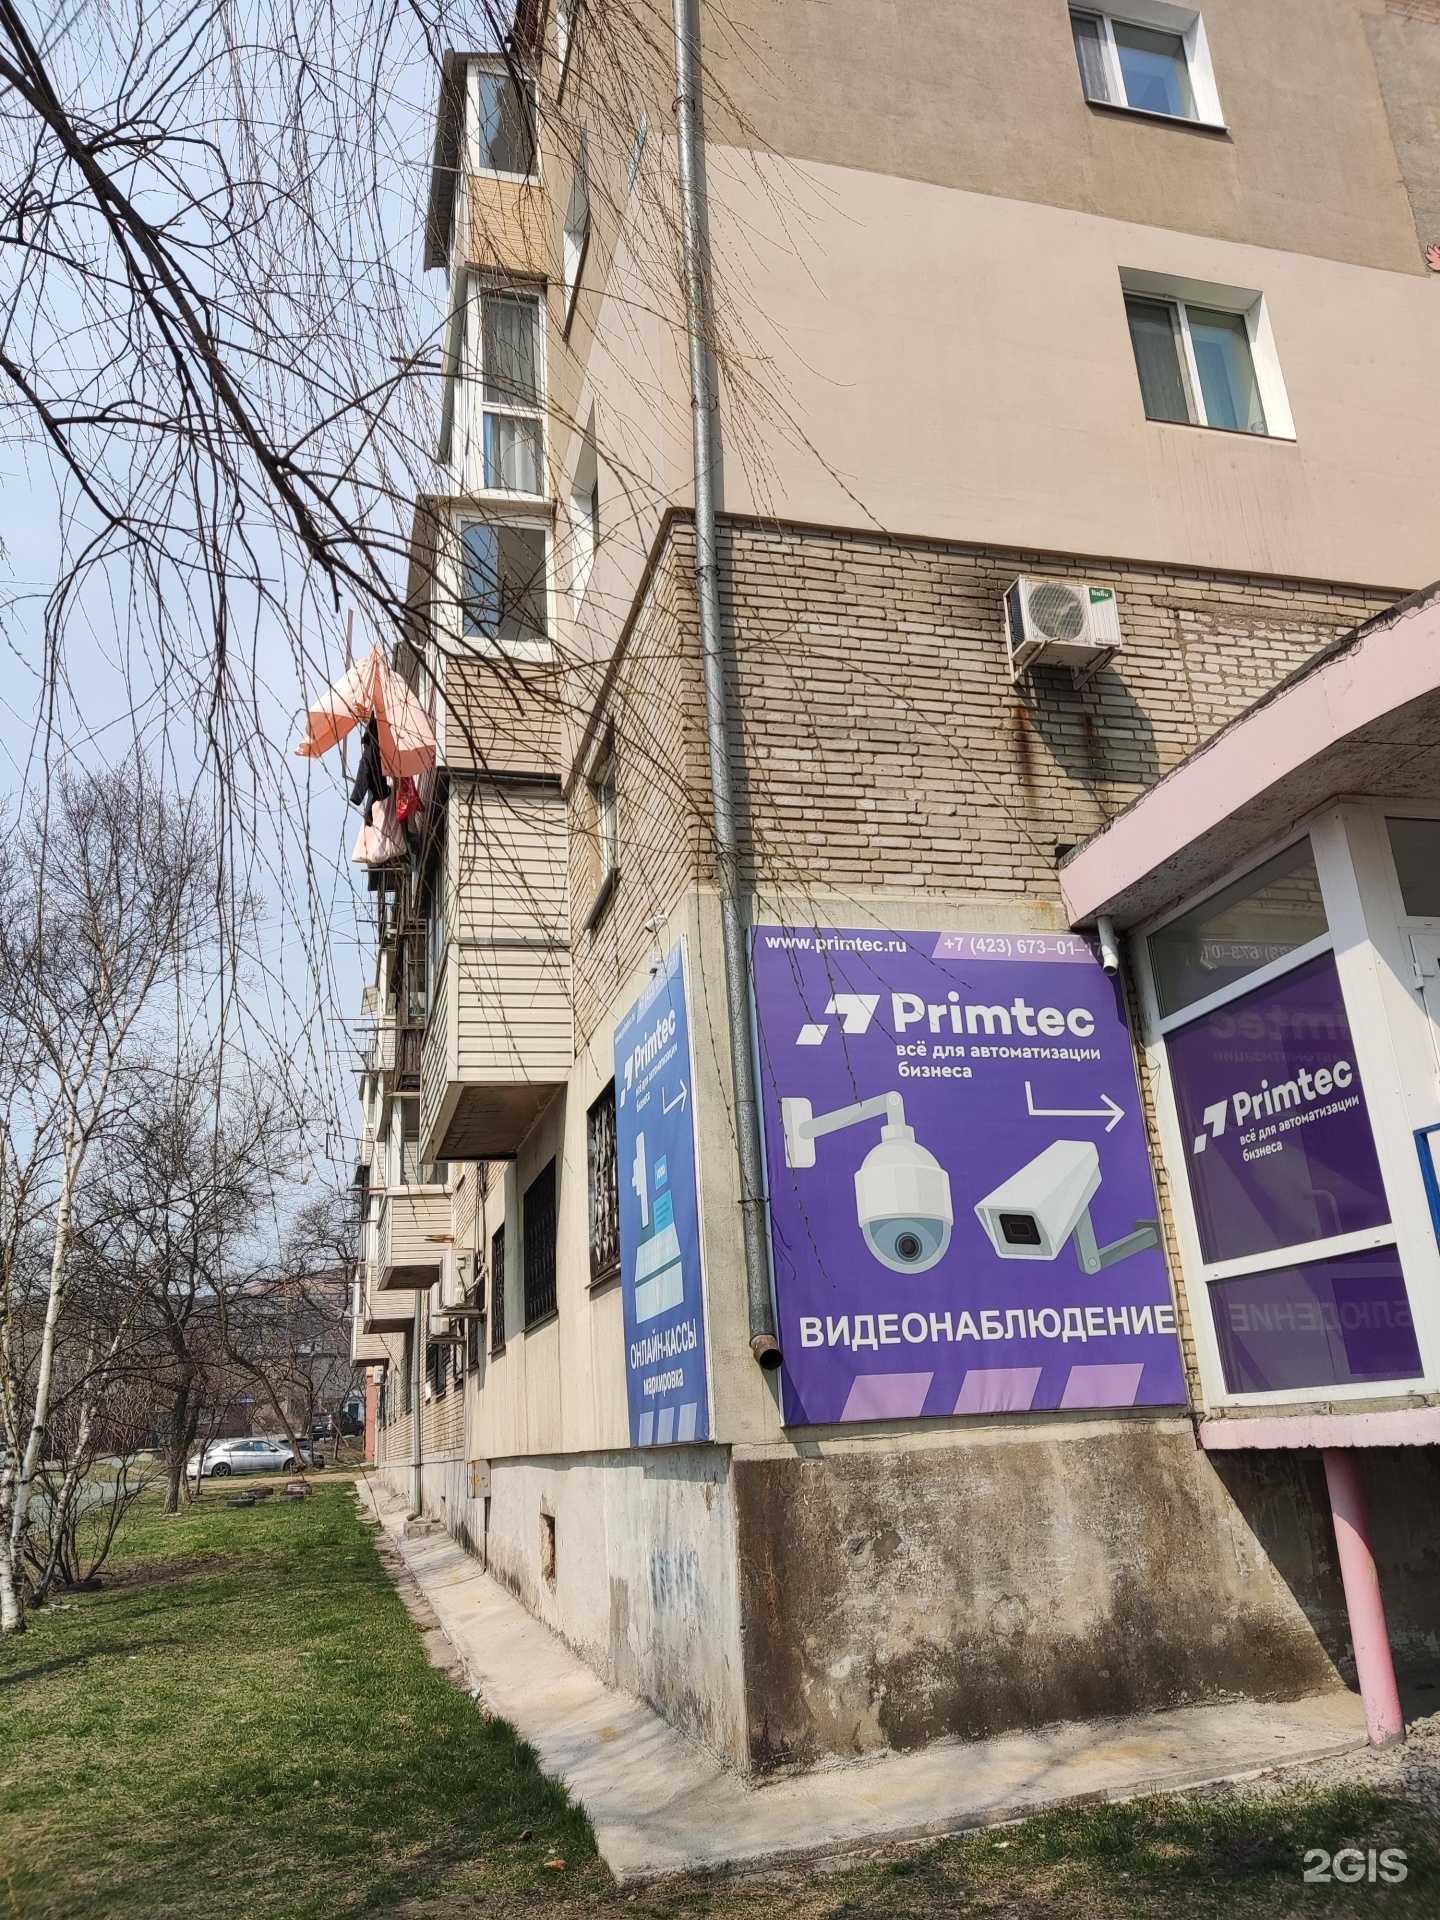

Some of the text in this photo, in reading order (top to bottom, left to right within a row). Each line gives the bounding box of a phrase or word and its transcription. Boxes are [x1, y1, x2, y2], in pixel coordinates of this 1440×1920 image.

[764, 935, 907, 954] www.primtec.ru
[943, 937, 964, 952] +7
[969, 937, 1012, 957] (423)
[891, 991, 1095, 1038] Primtec
[634, 1009, 676, 1079] Primtec
[896, 1041, 1101, 1062] всё для автоматизации
[898, 1061, 973, 1079] бизнеса
[1232, 1060, 1353, 1127] Primtec
[1239, 1095, 1361, 1146] всё для автоматизации
[1242, 1140, 1283, 1162] бизнеса
[630, 1317, 697, 1370] ОНЛАЙН-КАССЫ
[799, 1304, 1177, 1350] ВИДЕОНАБЛЮДЕНИЕ
[643, 1367, 684, 1400] маркировка
